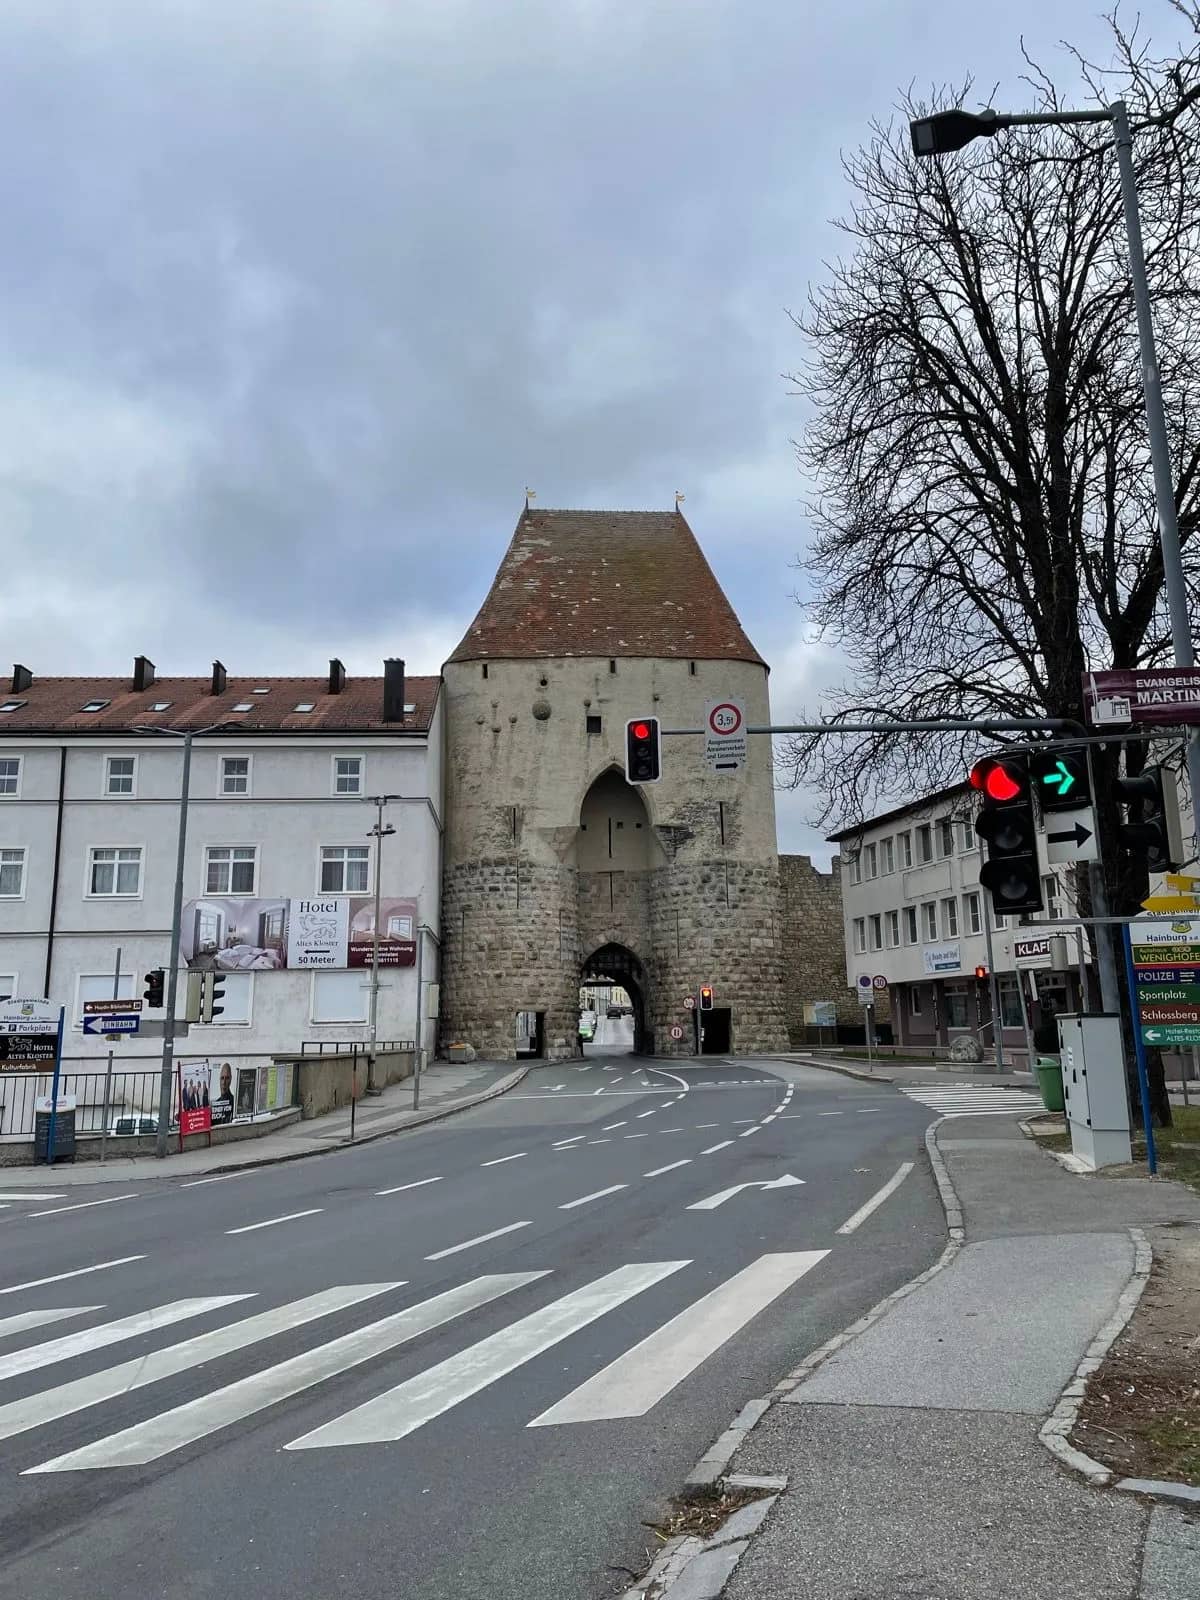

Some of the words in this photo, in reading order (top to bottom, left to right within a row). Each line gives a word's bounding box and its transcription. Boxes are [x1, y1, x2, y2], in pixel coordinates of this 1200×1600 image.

[1136, 676, 1200, 688] EVANGELIS
[1137, 689, 1200, 704] MARTIN
[300, 901, 338, 913] Hotel
[1146, 935, 1187, 944] Hainburg
[1138, 972, 1175, 981] POLIZEI
[1139, 990, 1187, 1000] Sportplatz
[1141, 1009, 1198, 1021] Schlossberg
[19, 1024, 52, 1032] Parkplatz
[103, 1020, 134, 1028] EINBAHN
[1, 1063, 37, 1071] Kulturfabrik
